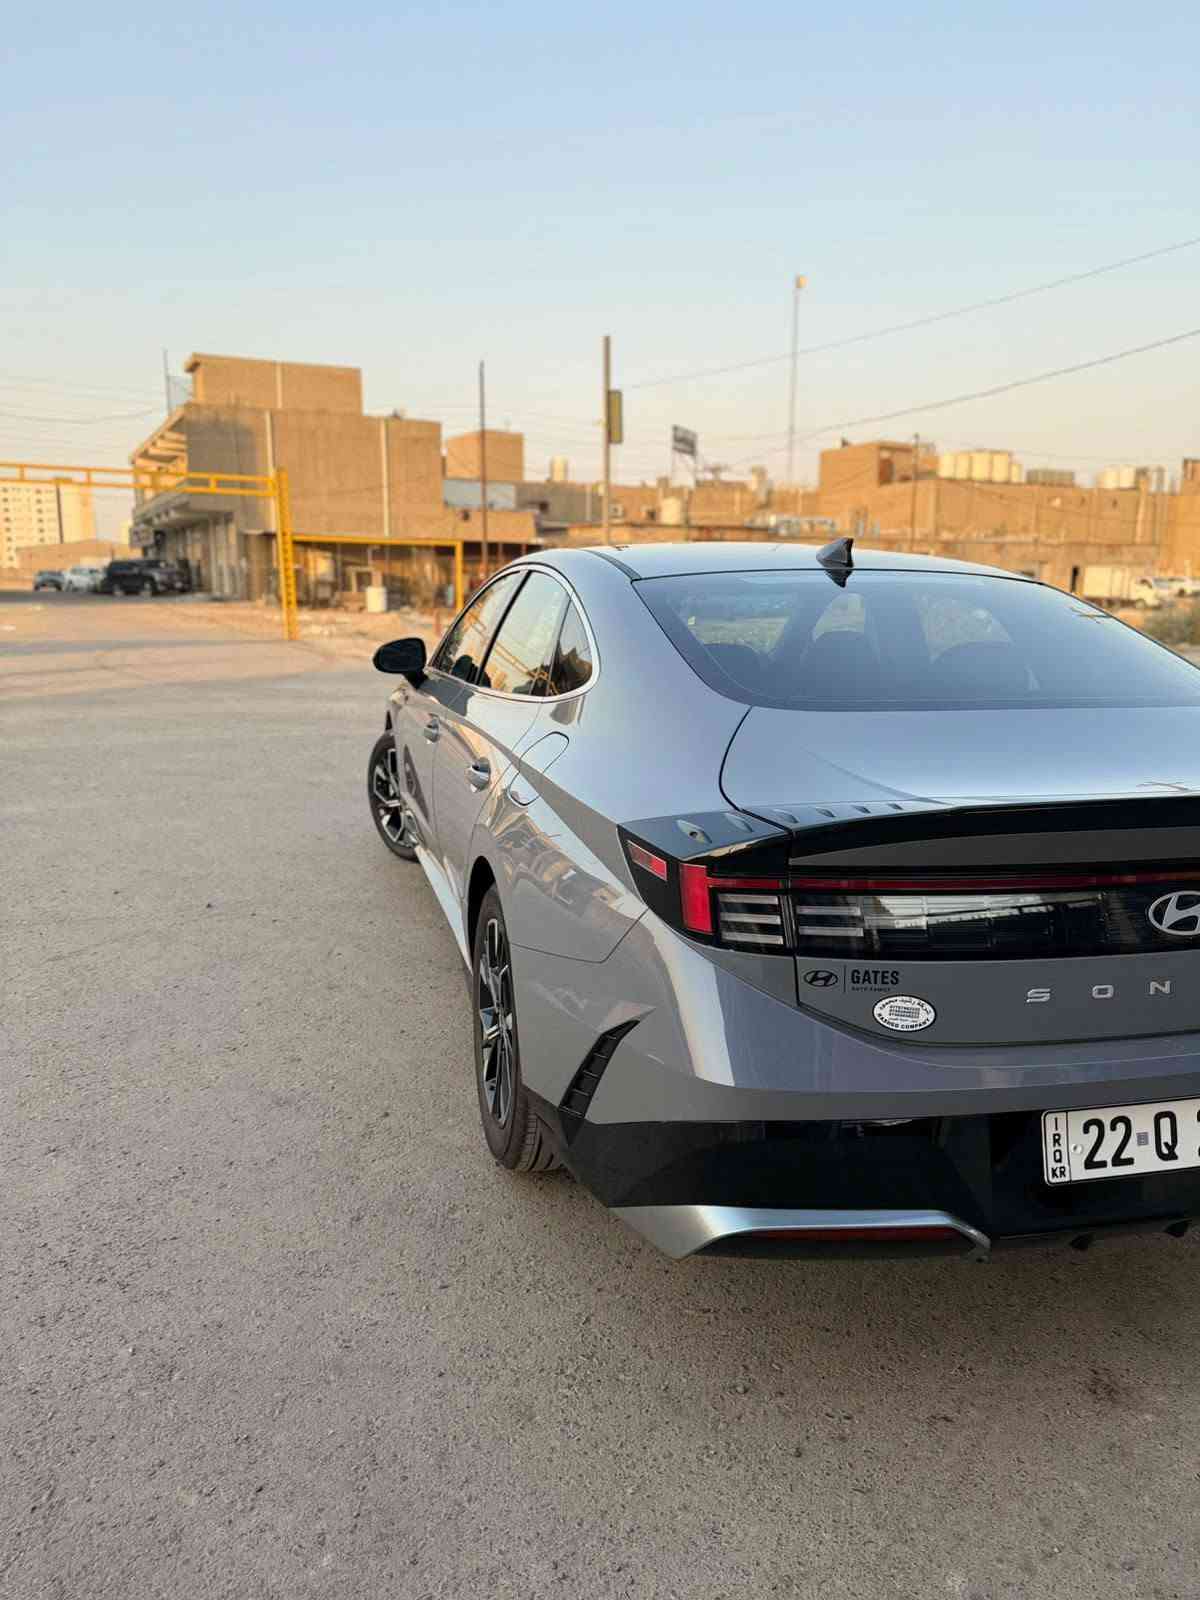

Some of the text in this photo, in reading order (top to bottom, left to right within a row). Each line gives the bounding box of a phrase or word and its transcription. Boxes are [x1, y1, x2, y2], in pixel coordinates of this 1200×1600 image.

[851, 969, 900, 985] GATES
[901, 1018, 930, 1030] COMPANY
[1082, 1115, 1135, 1170] 22
[1153, 1111, 1178, 1161] Q
[1051, 1166, 1067, 1179] KR
